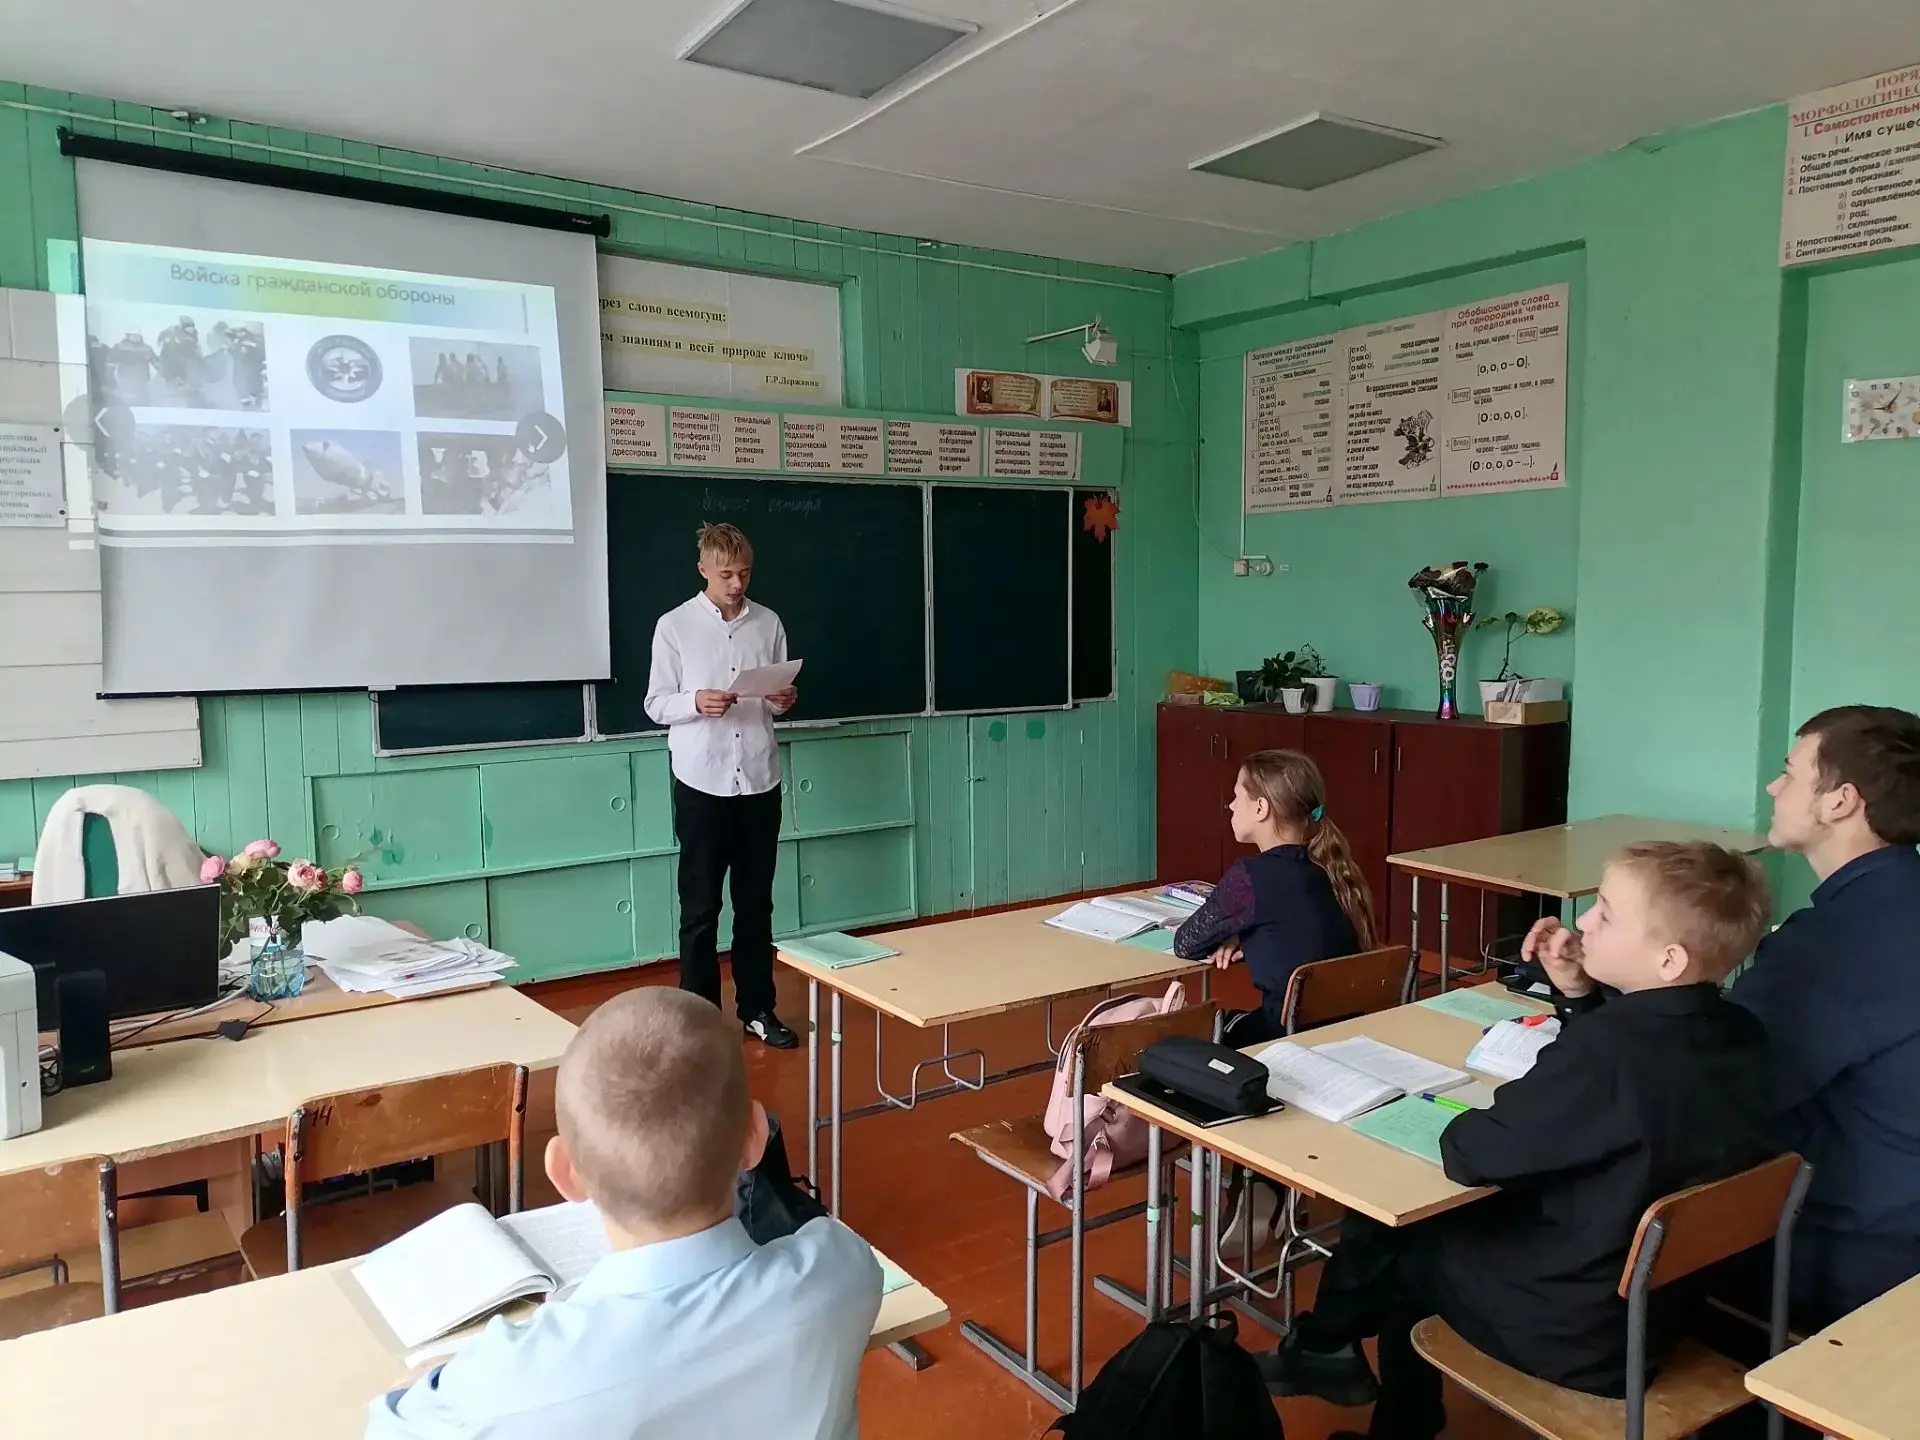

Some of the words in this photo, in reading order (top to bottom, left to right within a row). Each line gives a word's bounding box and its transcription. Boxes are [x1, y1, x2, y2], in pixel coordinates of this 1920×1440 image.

[1875, 68, 1920, 89] ПОРЯ
[1844, 128, 1872, 144] Имя
[1799, 161, 1831, 173] Общее
[1833, 147, 1892, 166] лексическое
[1801, 152, 1827, 162] Часть
[1799, 169, 1847, 184] Начальная
[1849, 161, 1881, 174] форма
[1798, 178, 1853, 195] Постоянные
[1851, 178, 1913, 197] собственное
[1796, 231, 1862, 247] Непостоянные
[1795, 240, 1868, 258] Синтаксическая
[170, 262, 241, 288] Войска
[247, 270, 371, 300] гражданской
[375, 283, 457, 307] обороны
[599, 298, 621, 310] рез
[628, 301, 662, 315] слово
[1458, 300, 1519, 320] Обобщающие
[1521, 294, 1550, 306] слова
[1451, 320, 1467, 330] при
[1469, 308, 1523, 325] однородных
[1526, 301, 1560, 312] членах
[1473, 314, 1534, 333] предложения
[621, 335, 672, 349] знаниям
[675, 341, 683, 350] и
[689, 342, 714, 353] всей
[722, 347, 766, 362] природе
[773, 351, 808, 362] ключ»
[610, 408, 636, 417] террор
[672, 411, 709, 421] перископы
[734, 416, 772, 425] гениальный
[611, 428, 636, 436] пресса
[672, 421, 708, 430] перипетии
[612, 439, 652, 447] пессимизм
[673, 432, 710, 441] периферия
[734, 437, 760, 445] ревизия
[840, 434, 878, 442] мусульманин
[673, 442, 710, 452] преамбула
[734, 446, 765, 454] реликвия
[673, 452, 706, 461] премьера
[310, 1105, 333, 1127] 14
